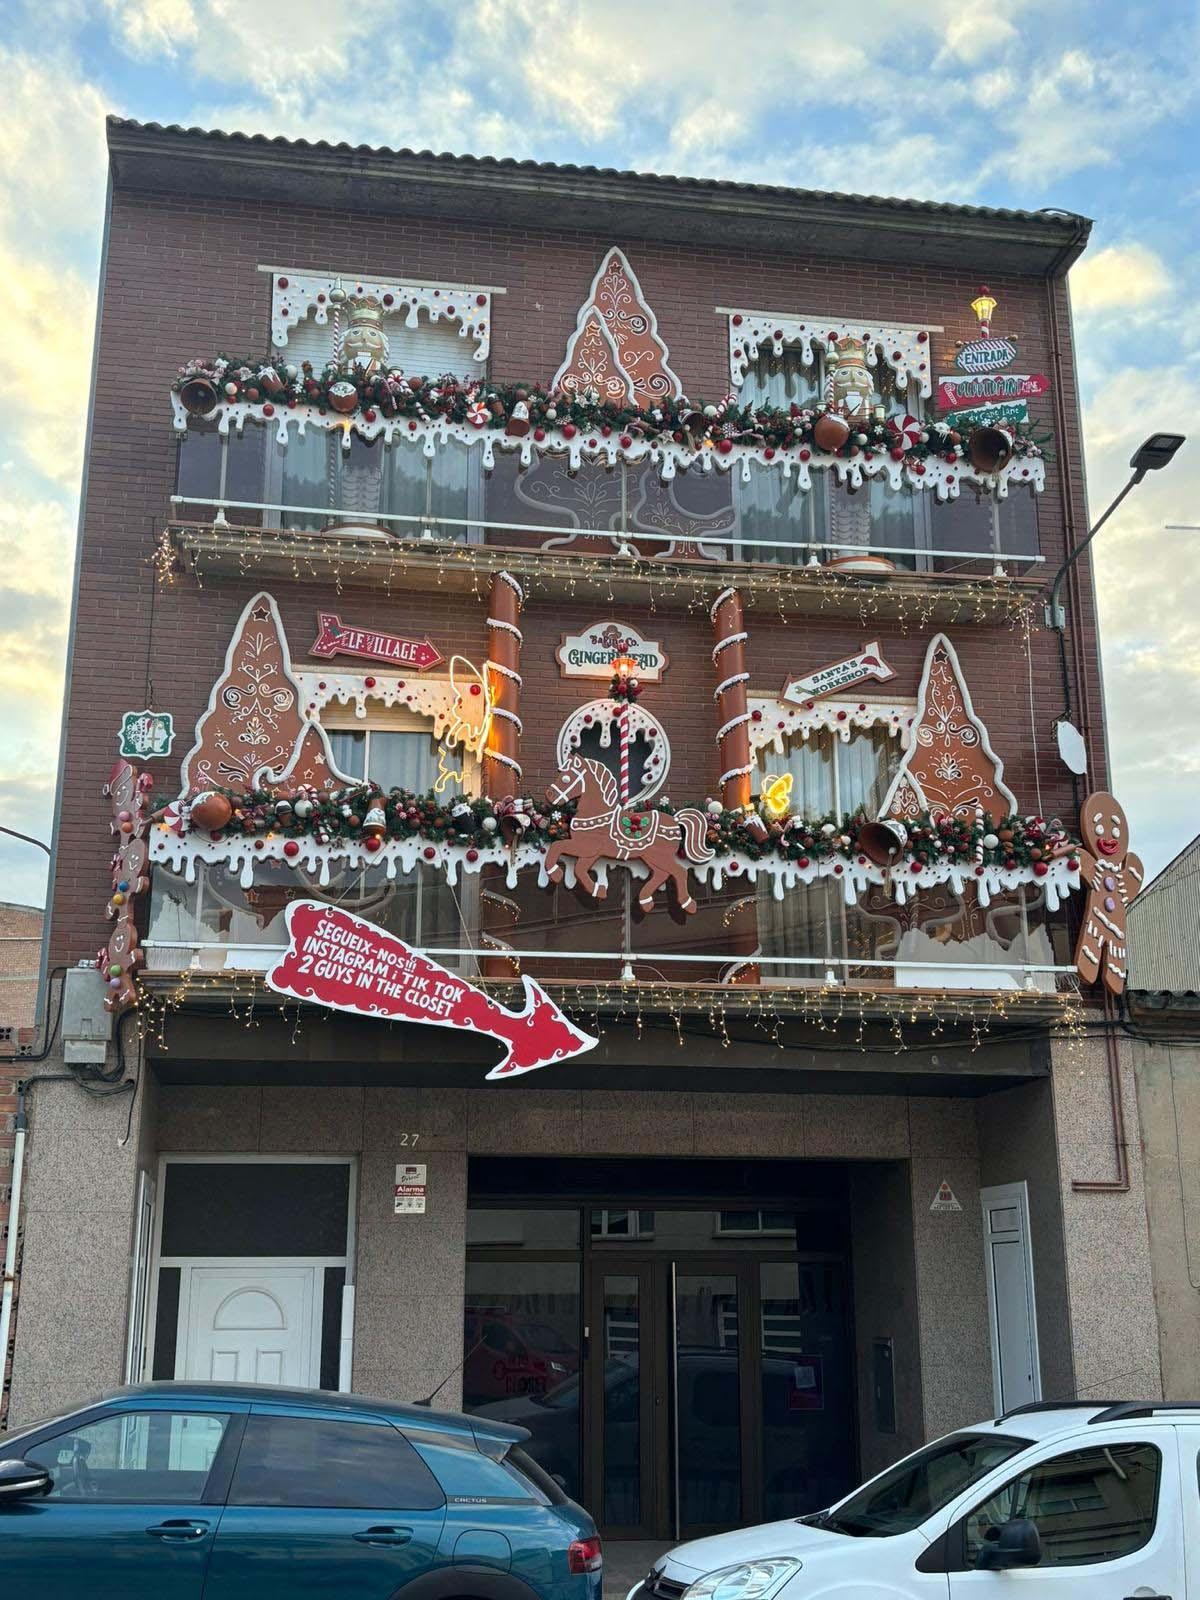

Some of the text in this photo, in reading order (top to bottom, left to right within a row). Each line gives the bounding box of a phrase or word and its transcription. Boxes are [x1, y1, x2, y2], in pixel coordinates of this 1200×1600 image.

[964, 348, 1009, 365] ENTRADA
[1002, 406, 1020, 417] Lane
[366, 634, 419, 661] VILLAGE
[810, 667, 869, 696] WORKSHOP
[812, 660, 858, 684] SANTA'S
[314, 919, 417, 973] SEGUEIX-NOS!!!
[302, 936, 389, 978] INSTAGRAM
[401, 971, 431, 991] TIK
[434, 981, 466, 1003] TOK
[297, 955, 455, 1018] 2 GUYS IN THE CLOSET
[400, 1133, 420, 1147] 27
